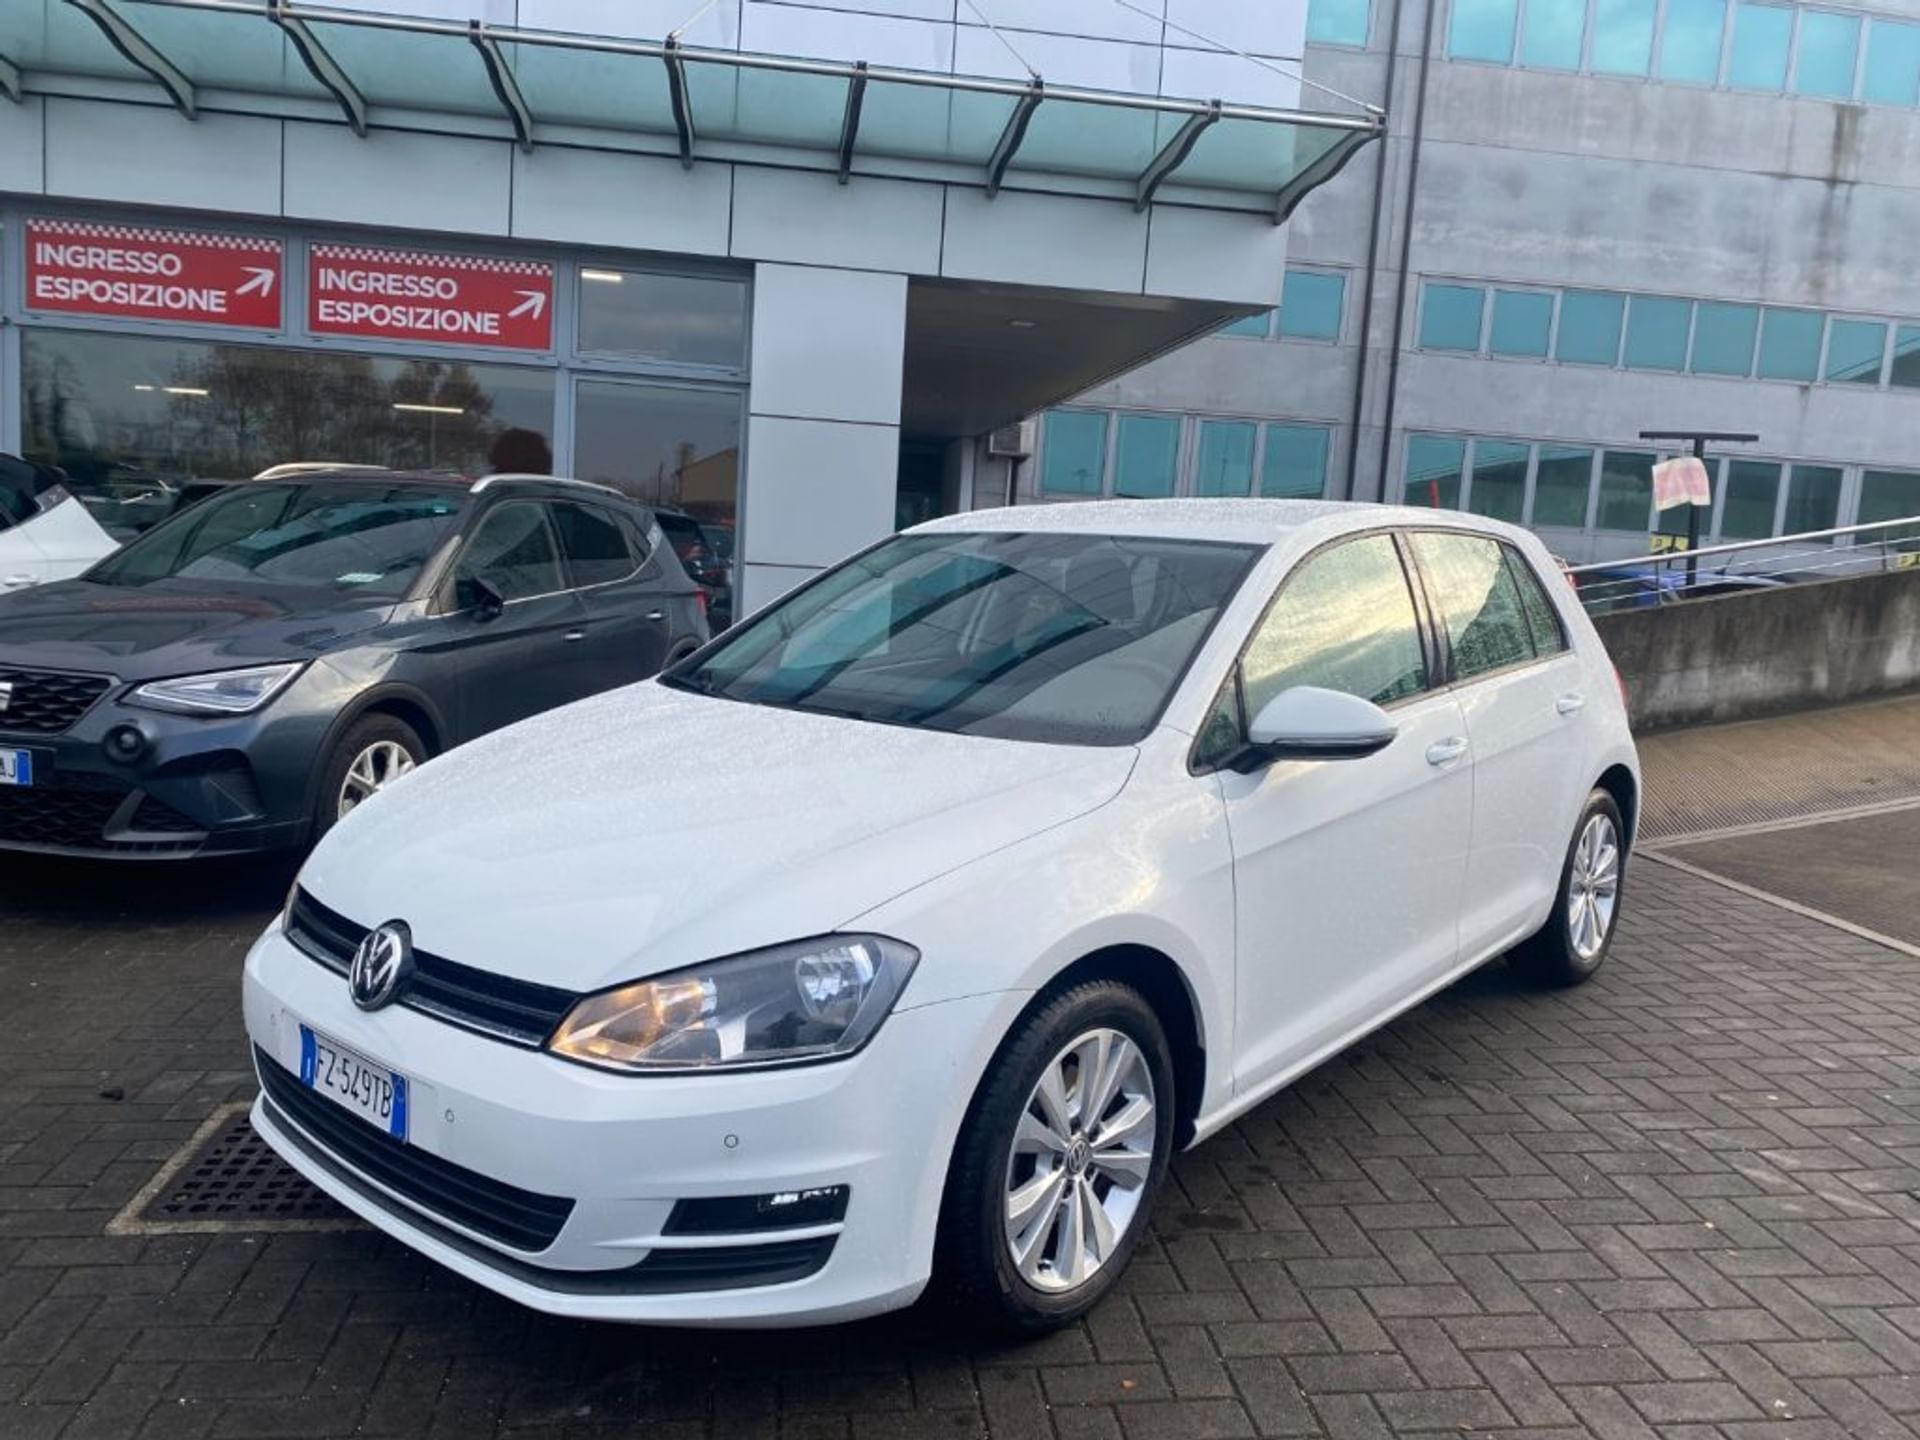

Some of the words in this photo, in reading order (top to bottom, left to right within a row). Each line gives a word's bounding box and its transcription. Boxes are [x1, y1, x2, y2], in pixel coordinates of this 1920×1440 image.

[35, 242, 182, 276] INGRESSO
[35, 276, 227, 313] ESPOSIZIONE
[318, 267, 458, 300] INGRESSO
[318, 300, 500, 335] ESPOSIZIONE
